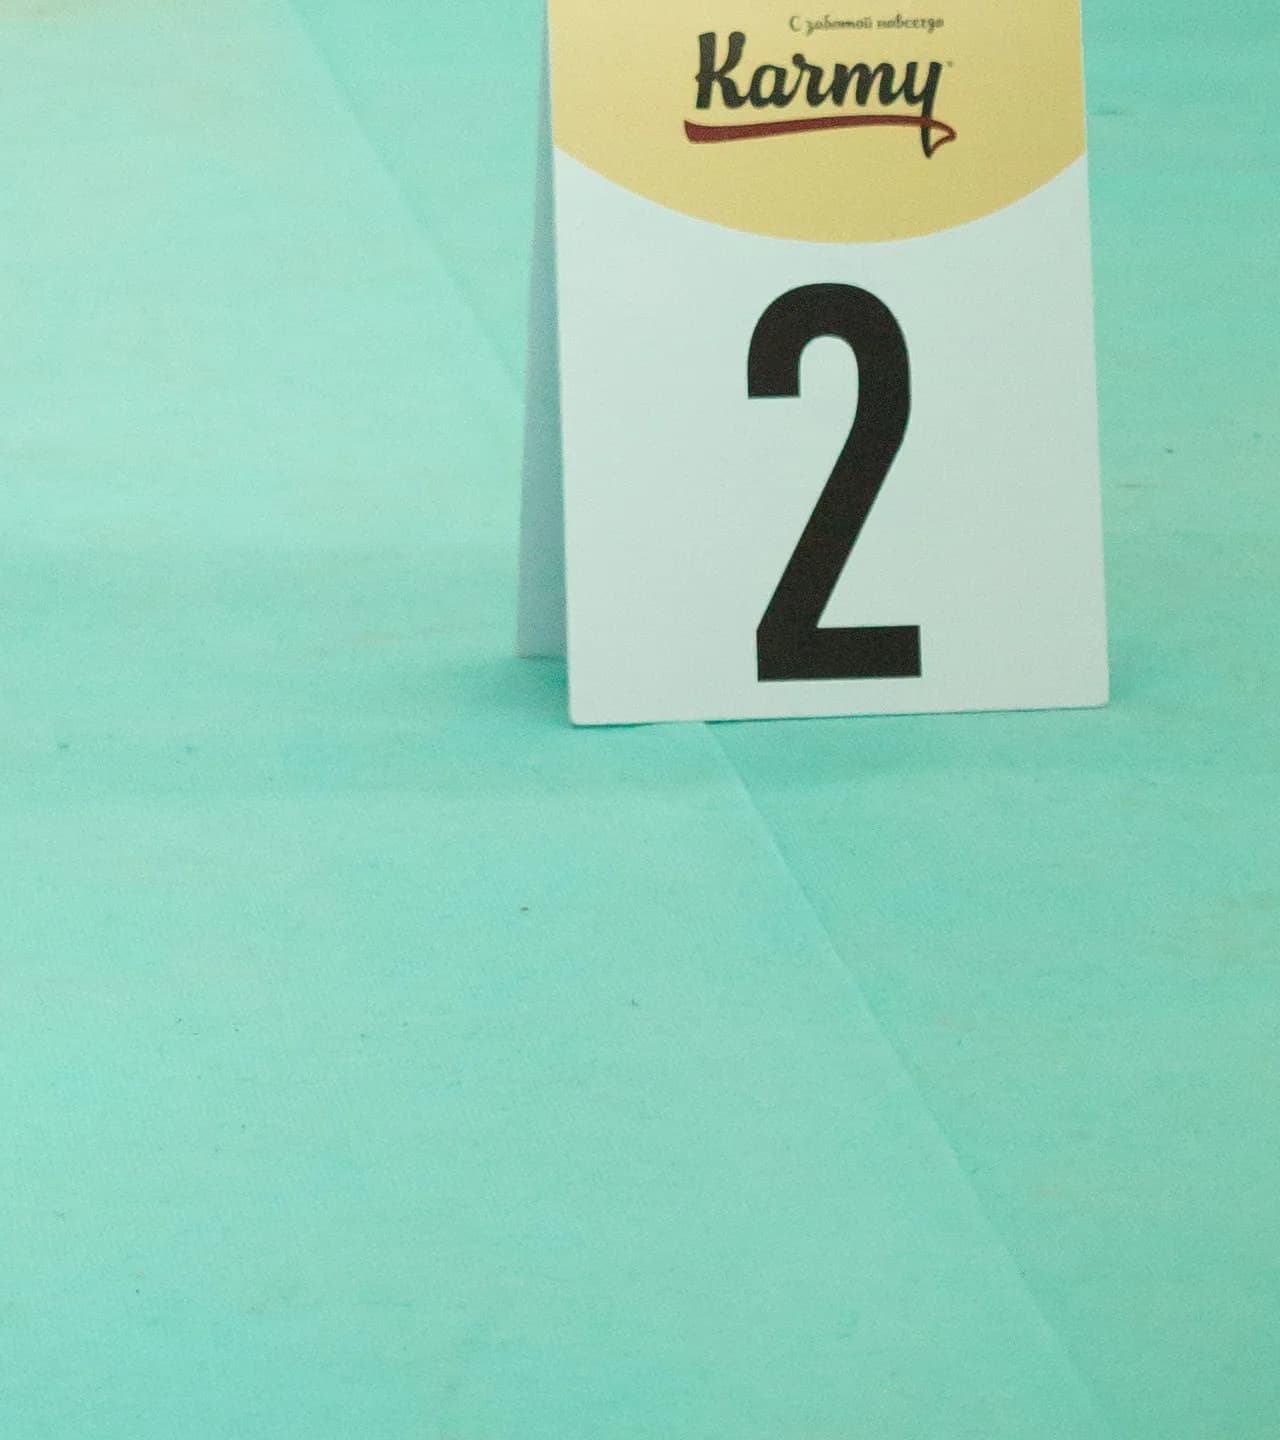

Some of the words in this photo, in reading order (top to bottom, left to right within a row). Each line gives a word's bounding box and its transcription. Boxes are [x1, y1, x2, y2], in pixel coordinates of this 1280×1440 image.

[789, 15, 801, 31] С
[694, 31, 943, 159] Karmy
[747, 282, 922, 682] 2
